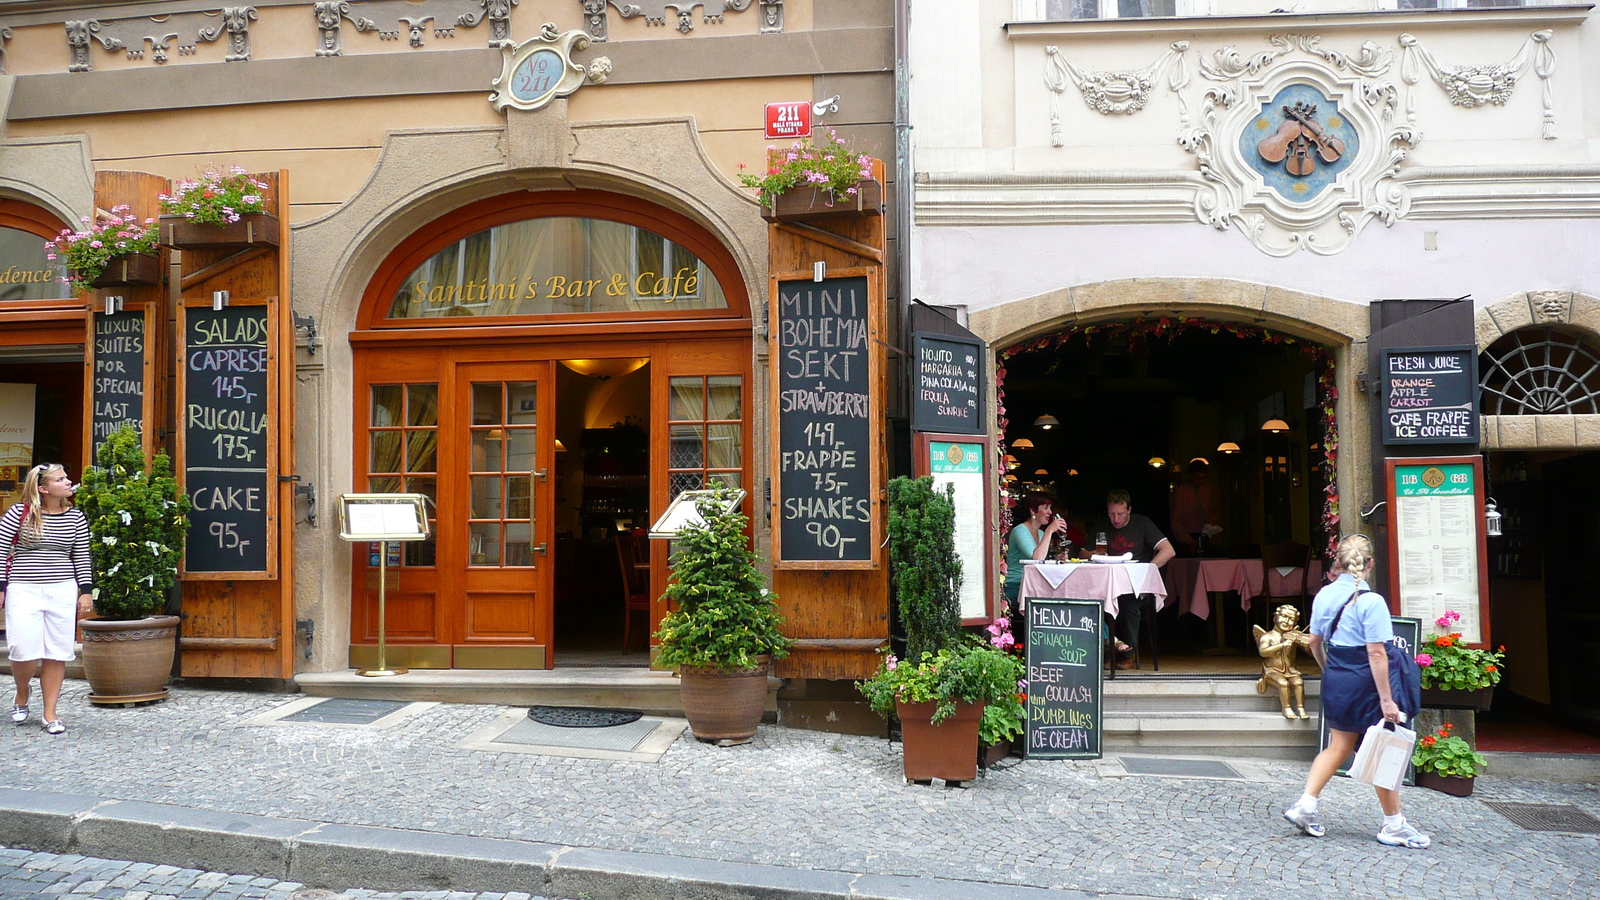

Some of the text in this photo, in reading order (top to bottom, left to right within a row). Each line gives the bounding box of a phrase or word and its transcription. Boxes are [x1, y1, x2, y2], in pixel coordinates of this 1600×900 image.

[520, 75, 551, 92] 211
[777, 105, 799, 121] 211
[545, 275, 602, 299] Bar
[605, 273, 627, 297] &
[634, 267, 699, 303] Café
[781, 289, 857, 317] MINI
[96, 318, 144, 335] LUXURY
[194, 317, 267, 345] SALADS
[782, 317, 868, 350] BOHEMIA
[96, 336, 142, 353] SUITES
[189, 349, 267, 372] CAPRESE
[921, 348, 953, 363] MOJITO
[1389, 356, 1462, 371] FRESH JUICE
[97, 360, 126, 373] FOR
[786, 349, 858, 382] SEKT
[921, 362, 963, 377] MARGARITA
[95, 377, 143, 396] SPECIAL
[921, 375, 940, 388] PINA
[940, 378, 968, 392] COLADA
[1391, 379, 1436, 388] ORANGE
[921, 389, 950, 405] TEQUILA
[1389, 388, 1429, 398] APPLE
[95, 401, 129, 418] LAST
[781, 389, 868, 418] STRAWBERRY
[1390, 398, 1433, 407] CARROT
[188, 404, 267, 434] RUCOLLA
[1390, 411, 1471, 426] CAFE FRAPPE
[1395, 425, 1468, 438] ICE COFFEE
[782, 450, 856, 472] FRAPPE
[1401, 474, 1418, 485] 16
[192, 486, 261, 511] CAKE
[784, 496, 871, 522] SHAKES
[1032, 606, 1072, 627] MENU
[1031, 631, 1073, 647] SPINACH
[1058, 648, 1087, 664] SOUP
[1030, 666, 1064, 682] BEEF
[1045, 684, 1093, 703] GOULASH
[1031, 705, 1093, 729] DUMPLINGS
[1031, 728, 1089, 750] ICE CREAM
